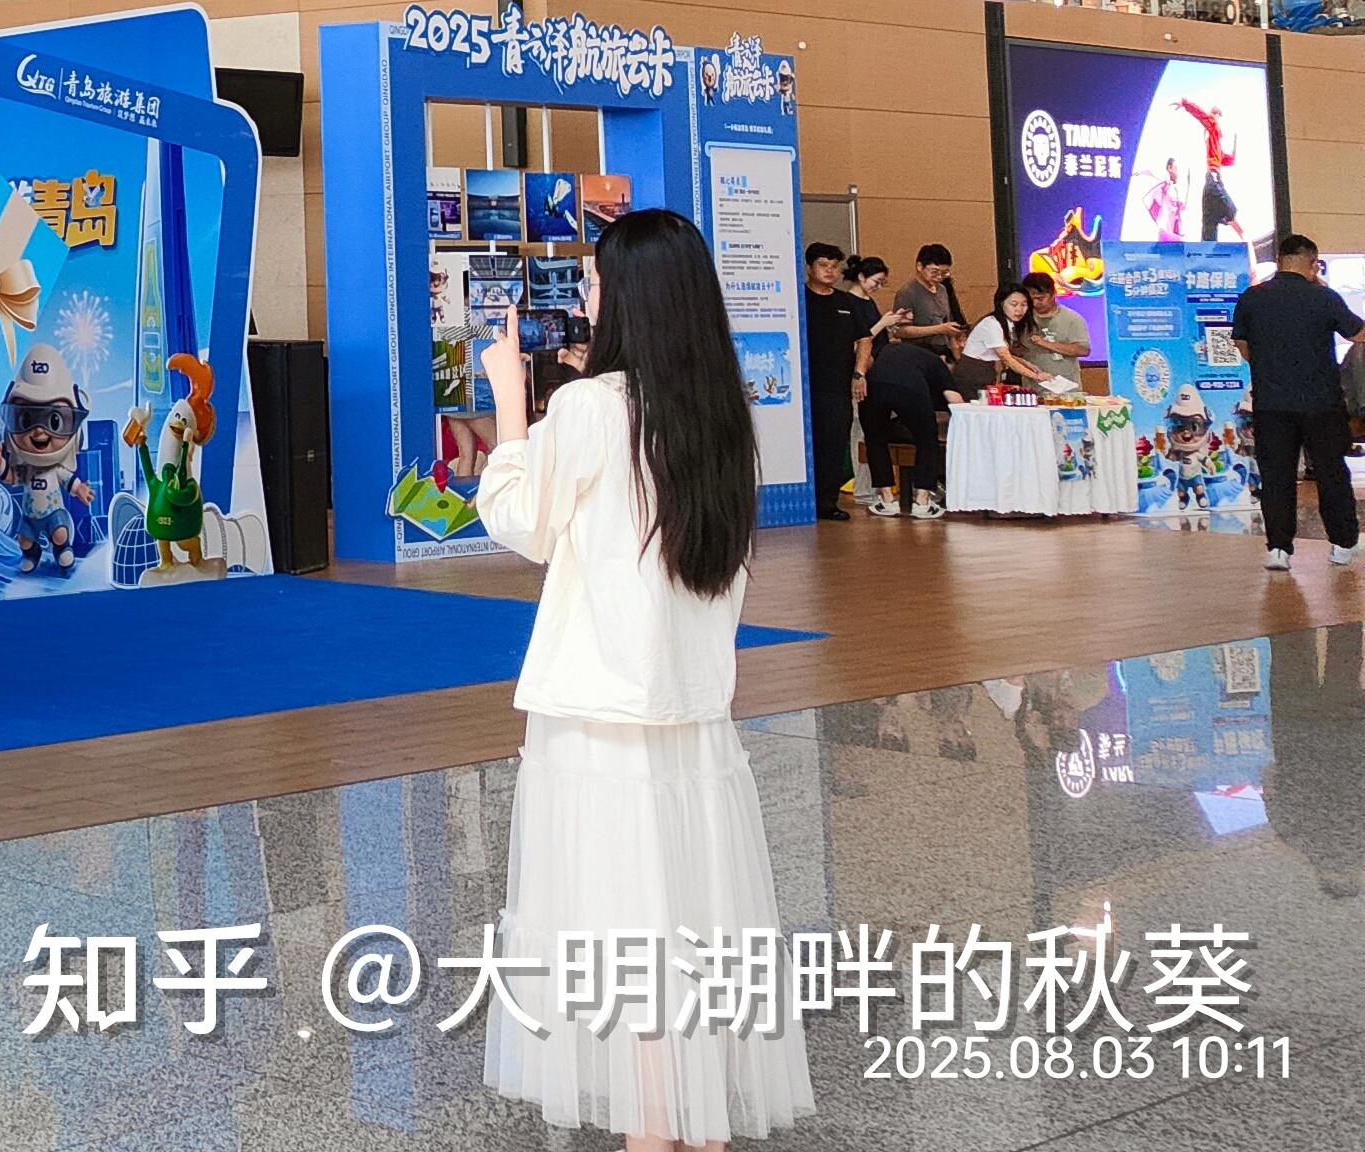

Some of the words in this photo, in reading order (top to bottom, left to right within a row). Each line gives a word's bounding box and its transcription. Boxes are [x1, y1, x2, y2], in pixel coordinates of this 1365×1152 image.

[63, 69, 161, 120] 青岛旅游集团
